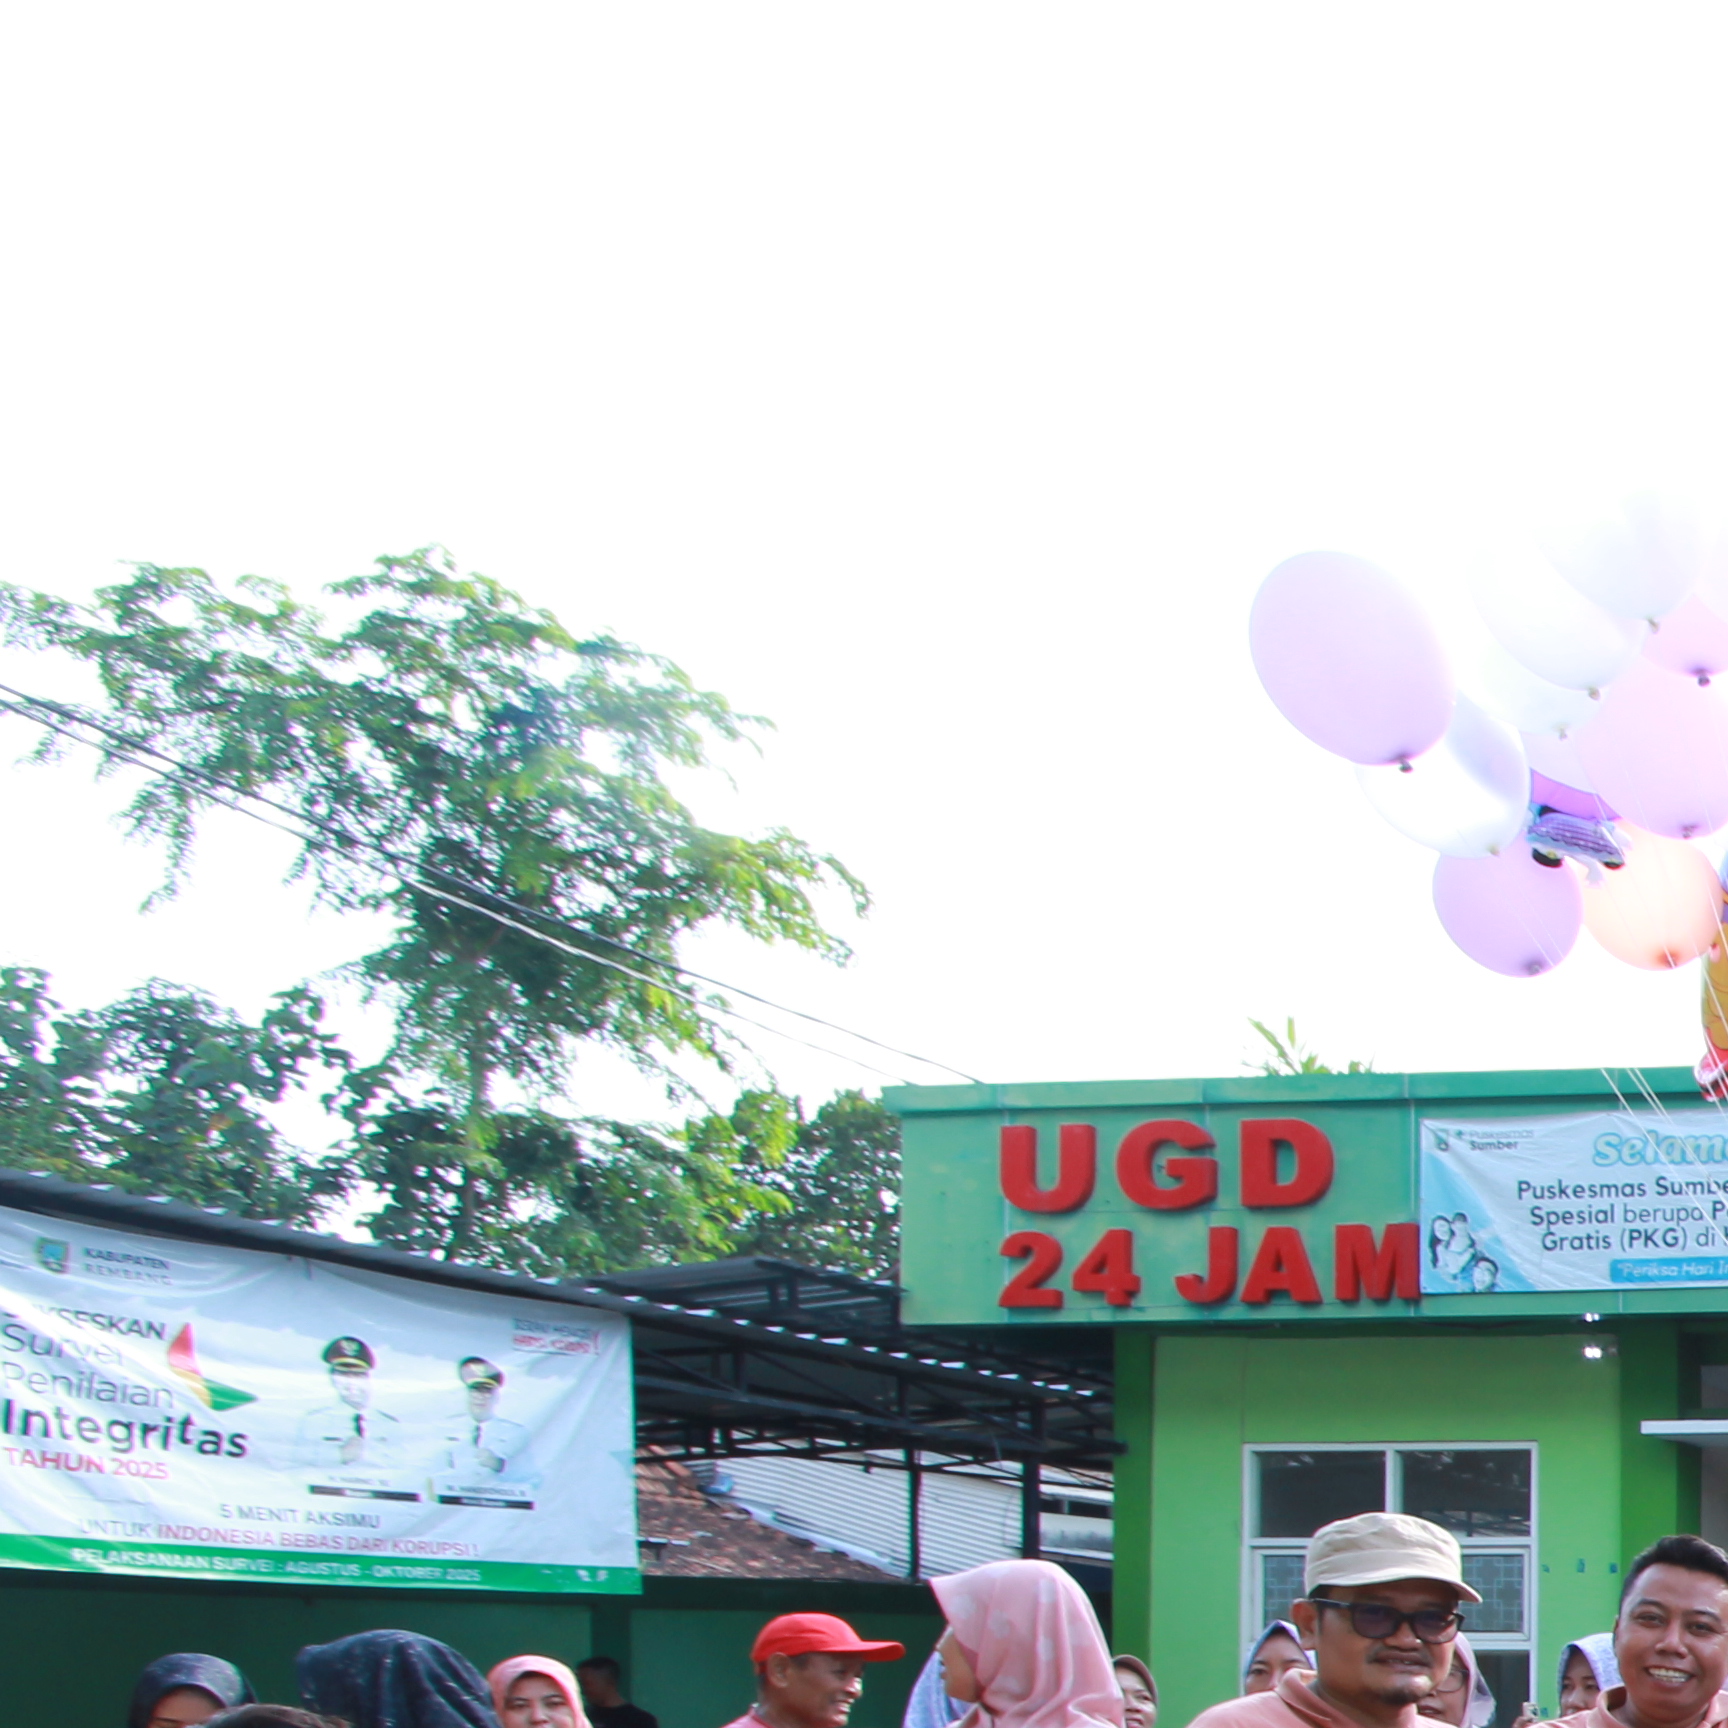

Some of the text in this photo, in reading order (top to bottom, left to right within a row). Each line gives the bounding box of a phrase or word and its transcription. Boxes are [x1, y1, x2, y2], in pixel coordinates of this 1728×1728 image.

[1469, 1140, 1518, 1151] Sumber
[1000, 1119, 1335, 1213] UGD
[1517, 1178, 1646, 1201] Puskesmas
[1530, 1204, 1615, 1230] Spesial
[1623, 1203, 1704, 1228] berupa
[1541, 1231, 1612, 1252] Gratis
[1620, 1227, 1688, 1252] (PKG)
[1695, 1227, 1716, 1248] di
[84, 1247, 172, 1270] KABUPATEN
[998, 1222, 1422, 1309] 24 JAM
[1681, 1261, 1715, 1277] Hari
[84, 1263, 174, 1286] REMBANG
[1, 1361, 175, 1409] Penilaian
[2, 1398, 250, 1459] Integritas
[4, 1447, 170, 1480] TAHUN 2025
[220, 1504, 382, 1529] 5 MENIT AKSIMU
[80, 1518, 152, 1539] UNTUK
[156, 1524, 275, 1546] INDONESIA
[280, 1532, 343, 1550] BEBAS
[346, 1535, 390, 1552] DARI
[392, 1539, 472, 1557] KORUPSI
[71, 1546, 212, 1571] PELAKSANAAN
[212, 1556, 277, 1573] SURVEI
[285, 1560, 361, 1578] AGUSTUS
[372, 1564, 443, 1581] OKTOBER
[445, 1566, 482, 1582] 2025
